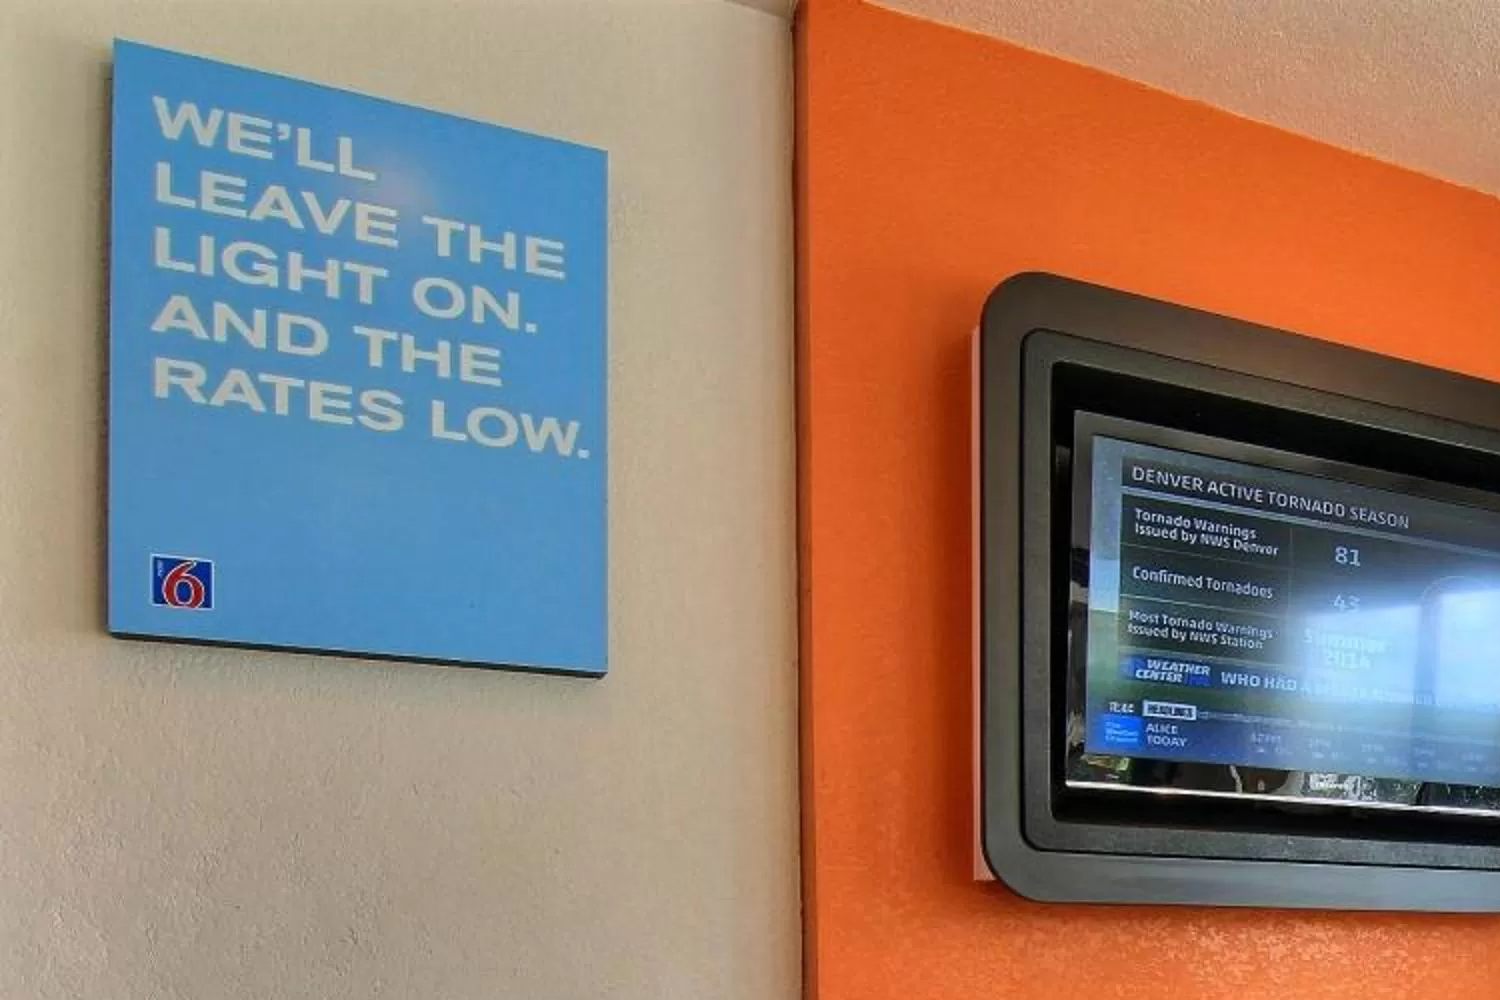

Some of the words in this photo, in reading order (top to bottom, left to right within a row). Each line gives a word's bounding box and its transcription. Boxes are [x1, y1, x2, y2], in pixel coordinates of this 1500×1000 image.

[152, 95, 377, 182] WE'LL
[155, 161, 399, 248] LEAVE
[423, 215, 566, 281] THE
[155, 227, 389, 304] LIGHT
[412, 276, 538, 334] ON.
[151, 295, 329, 357] AND
[353, 325, 502, 387] THE
[154, 357, 404, 433] RATES
[431, 399, 591, 460] LOW.
[1131, 465, 1204, 493] DENVER
[1207, 479, 1264, 504] ACTIVE
[1268, 490, 1346, 519] TORNADO
[1349, 507, 1410, 529] SEASON
[1135, 507, 1191, 529] Tornado
[1193, 518, 1257, 541] Warnings
[1135, 522, 1178, 540] Issued
[1181, 529, 1198, 545] by
[1200, 533, 1230, 549] NWS
[1233, 537, 1279, 556] Denver
[1334, 545, 1362, 568] 81
[161, 560, 205, 610] 6
[1132, 565, 1204, 589] Confirmed
[1206, 577, 1274, 599] Tornadoes
[1127, 622, 1170, 638] Issued
[1171, 627, 1187, 642] by
[1189, 630, 1218, 646] NWS
[1220, 633, 1264, 650] Station
[1129, 609, 1159, 625] Most
[1162, 614, 1213, 631] Tornado
[1215, 620, 1274, 641] Warnings
[1135, 669, 1183, 684] CENTER
[1147, 659, 1211, 677] WEATHER
[1220, 670, 1261, 688] WHO
[1264, 674, 1297, 692] HAD
[1146, 734, 1189, 747] TODAY
